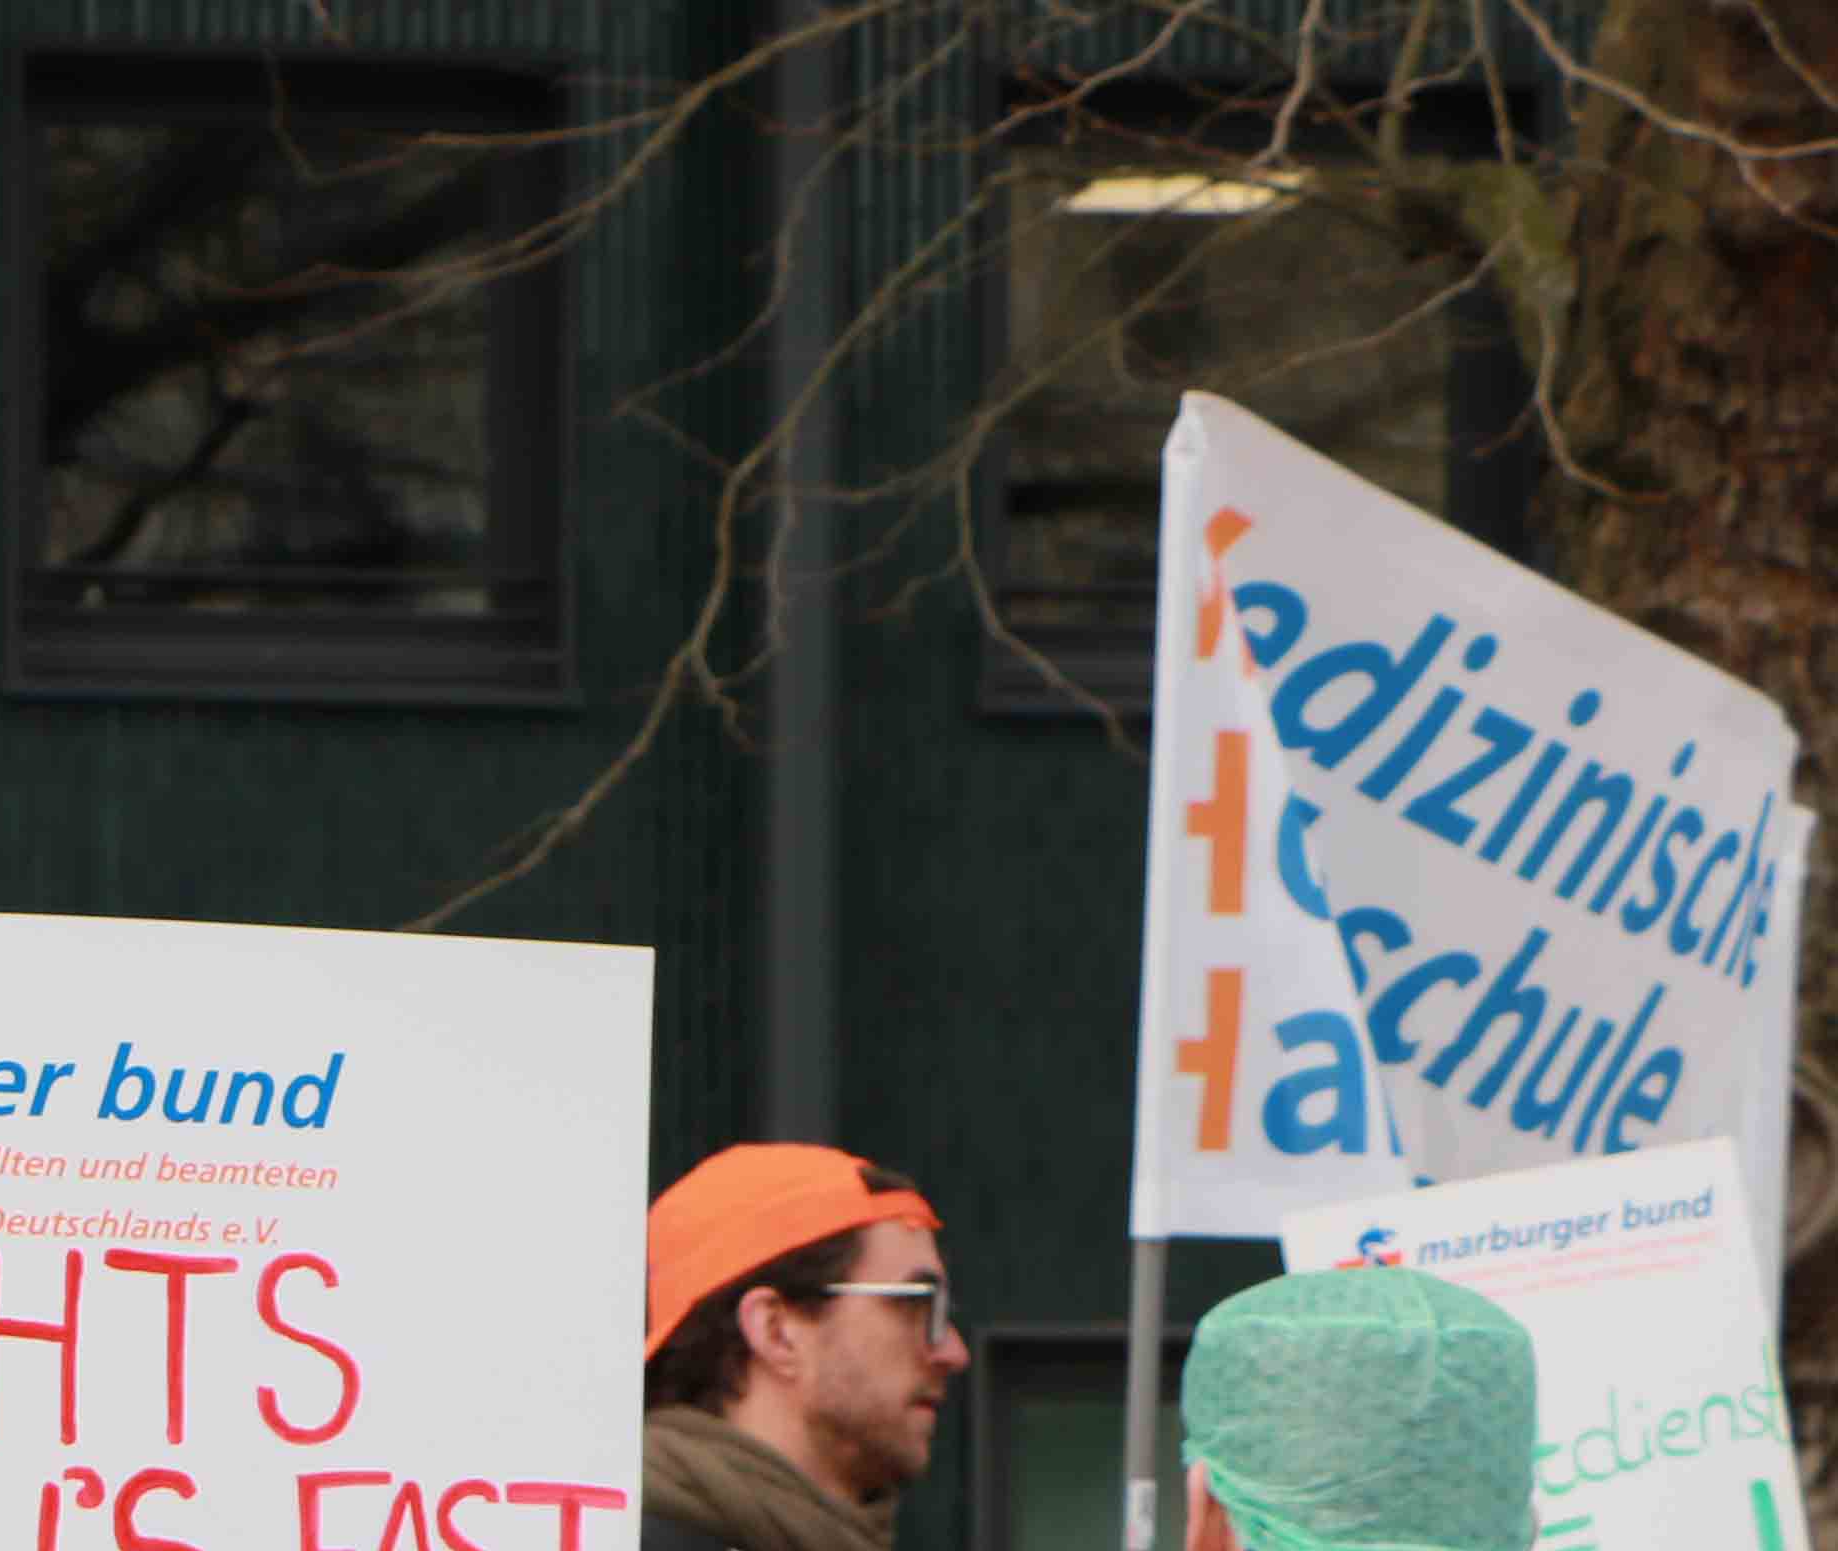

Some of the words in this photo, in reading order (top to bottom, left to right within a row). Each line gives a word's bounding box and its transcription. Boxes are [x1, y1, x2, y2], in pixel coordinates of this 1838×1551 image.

[98, 1042, 345, 1129] bund
[79, 1151, 149, 1184] und
[156, 1154, 339, 1190] beamteten
[221, 1215, 280, 1245] e.V.
[1417, 1210, 1611, 1266] marburger
[1619, 1187, 1715, 1231] bund
[1532, 1340, 1791, 1498] tdienst
